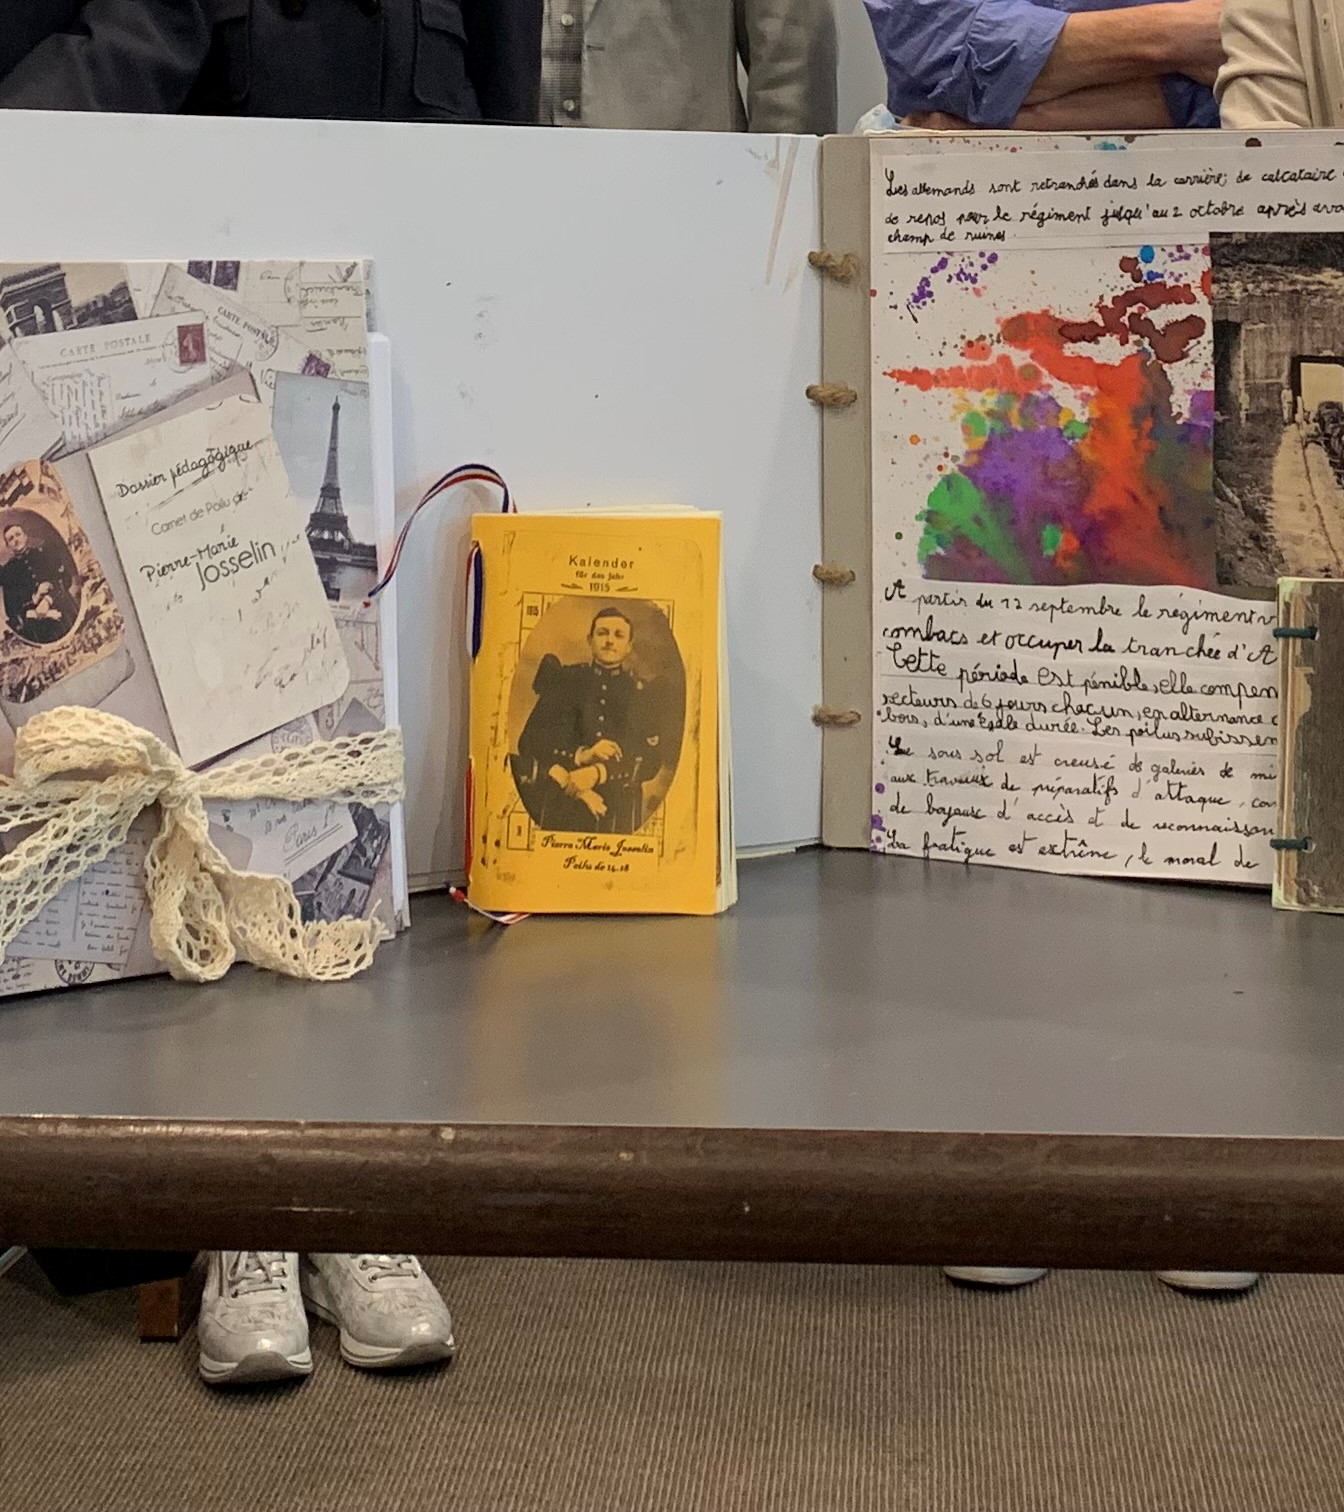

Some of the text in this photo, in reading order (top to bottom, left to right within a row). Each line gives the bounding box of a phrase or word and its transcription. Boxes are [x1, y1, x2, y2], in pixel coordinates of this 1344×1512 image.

[885, 168, 908, 197] Les
[911, 179, 976, 196] allemands
[989, 180, 1022, 193] sont
[1030, 170, 1099, 191] retranchés
[1104, 175, 1137, 190] dans
[1147, 173, 1166, 187] la
[1236, 170, 1252, 183] de
[885, 213, 898, 225] de
[993, 205, 1011, 222] le
[1020, 202, 1091, 227] régiment
[1173, 207, 1182, 218] 2
[1189, 200, 1245, 217] octobre
[1257, 199, 1306, 219] après
[887, 229, 934, 246] champ
[940, 227, 955, 240] de
[60, 344, 96, 358] CARTE
[104, 333, 150, 350] POSTALE
[116, 473, 167, 498] Dossier
[151, 514, 187, 536] Carnet
[190, 507, 205, 521] de
[205, 498, 231, 515] Poilu
[140, 535, 240, 582] Pierre-Marie
[196, 541, 277, 592] Josselin
[569, 554, 635, 569] Kalender
[912, 593, 968, 615] partir
[976, 593, 994, 609] du
[1028, 596, 1122, 623] septembre
[1132, 594, 1152, 618] le
[1156, 593, 1256, 635] régiment
[886, 642, 947, 676] Cette
[977, 631, 1002, 646] et
[1005, 633, 1083, 660] occuper
[1088, 627, 1116, 653] la
[883, 684, 957, 707] secteurs
[964, 690, 978, 708] de
[981, 693, 992, 708] 6
[995, 697, 1048, 721] jours
[1167, 701, 1263, 725] alternance
[1087, 716, 1120, 737] Les
[1126, 719, 1180, 746] poilus
[928, 747, 962, 760] sous
[970, 740, 1004, 763] sol
[1020, 743, 1042, 765] est
[1129, 752, 1142, 773] de
[1220, 762, 1234, 778] de
[891, 773, 917, 783] aux
[1001, 772, 1020, 791] de
[1033, 773, 1118, 805] préparatifs
[890, 791, 911, 814] de
[1088, 807, 1105, 827] et
[1121, 808, 1141, 830] de
[541, 834, 574, 848] Pierre
[1009, 830, 1038, 854] est
[1140, 841, 1153, 865] le
[1164, 842, 1221, 865] moral
[1234, 844, 1260, 869] de
[594, 861, 606, 871] de
